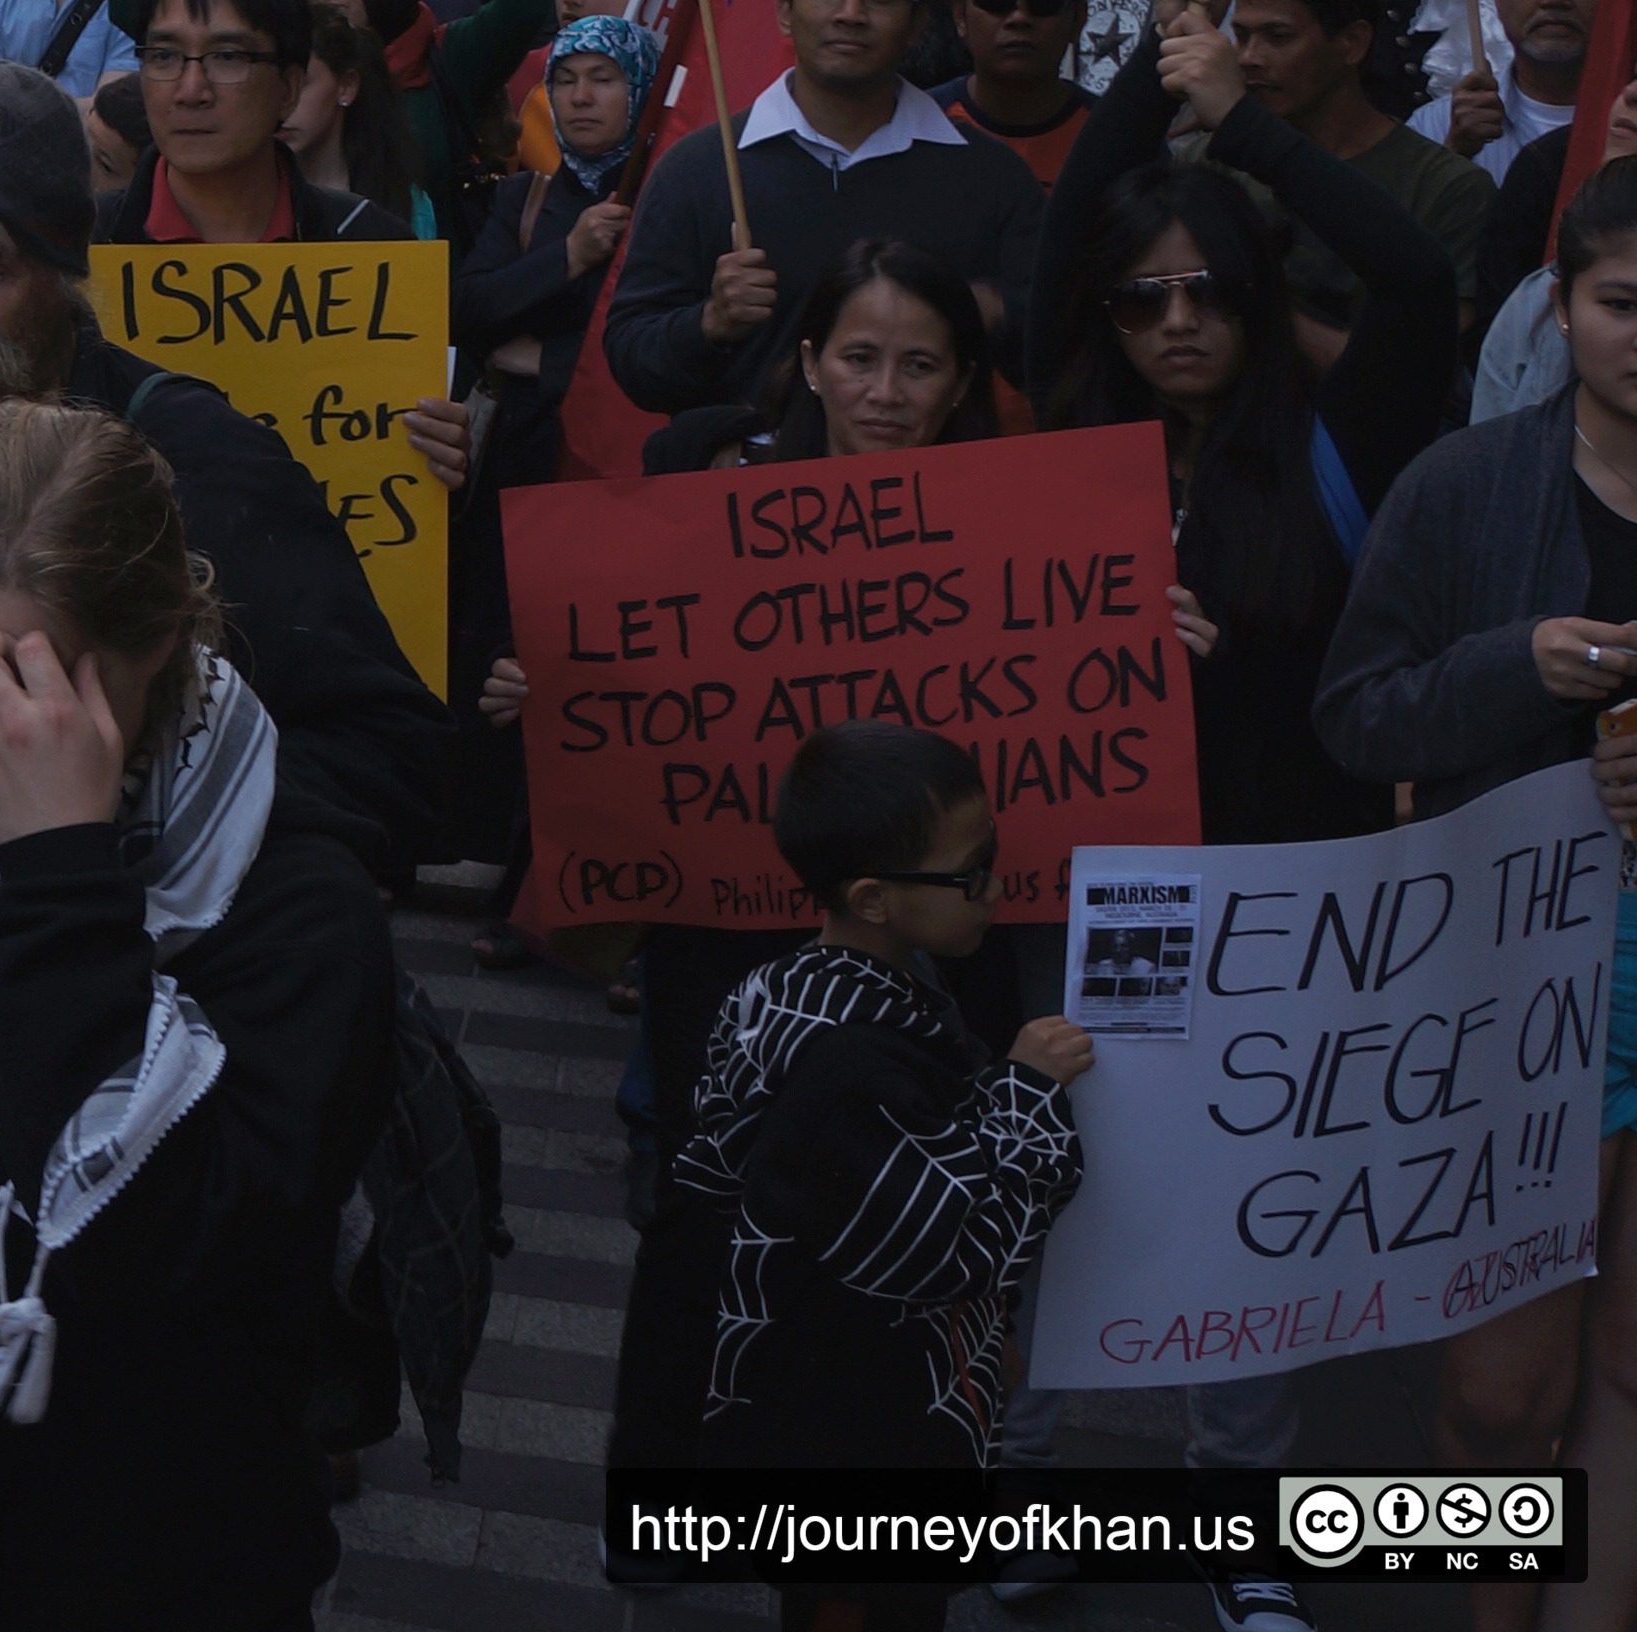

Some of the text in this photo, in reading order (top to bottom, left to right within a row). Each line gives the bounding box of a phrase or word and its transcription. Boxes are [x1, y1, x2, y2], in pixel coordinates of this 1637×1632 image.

[123, 259, 417, 345] ISRAEL
[305, 384, 409, 446] for
[727, 471, 953, 560] ISRAEL
[568, 553, 1141, 663] LET OTHERS LIVE
[561, 637, 1168, 754] STOP ATTACKS ON
[662, 727, 1149, 827] PALIANS
[1104, 886, 1179, 905] MARXISM
[1207, 831, 1608, 996] END THE
[1208, 962, 1602, 1138] SIEGE ON
[1099, 1279, 1386, 1364] GABRIELA
